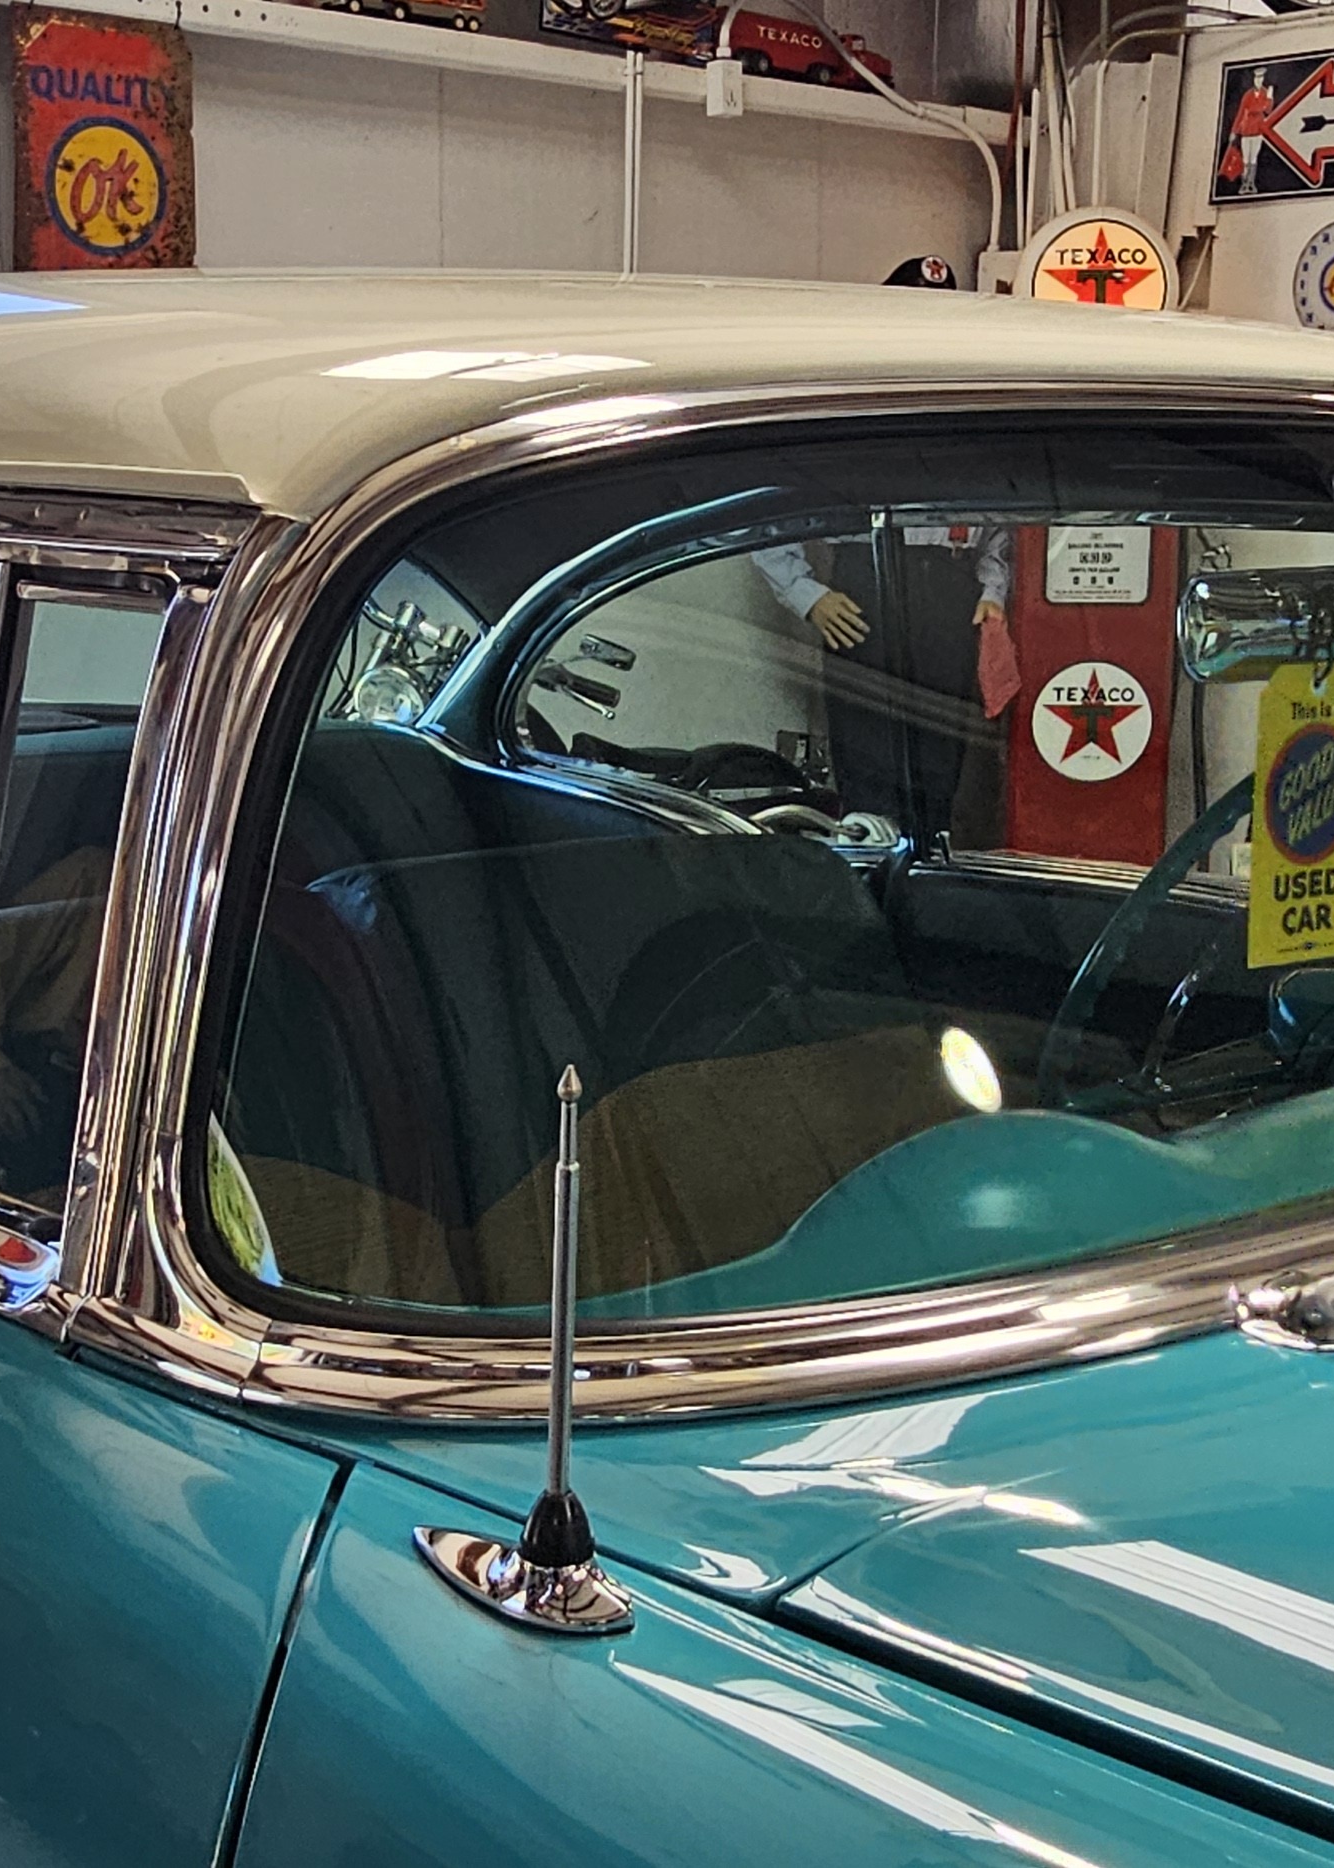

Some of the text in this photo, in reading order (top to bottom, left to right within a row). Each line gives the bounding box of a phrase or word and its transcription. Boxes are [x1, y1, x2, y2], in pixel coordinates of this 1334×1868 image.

[756, 24, 822, 49] TEXACO
[70, 148, 144, 222] OK
[1055, 248, 1147, 265] TEXACO
[1052, 687, 1135, 702] TEXACO
[1281, 904, 1333, 936] CAR
